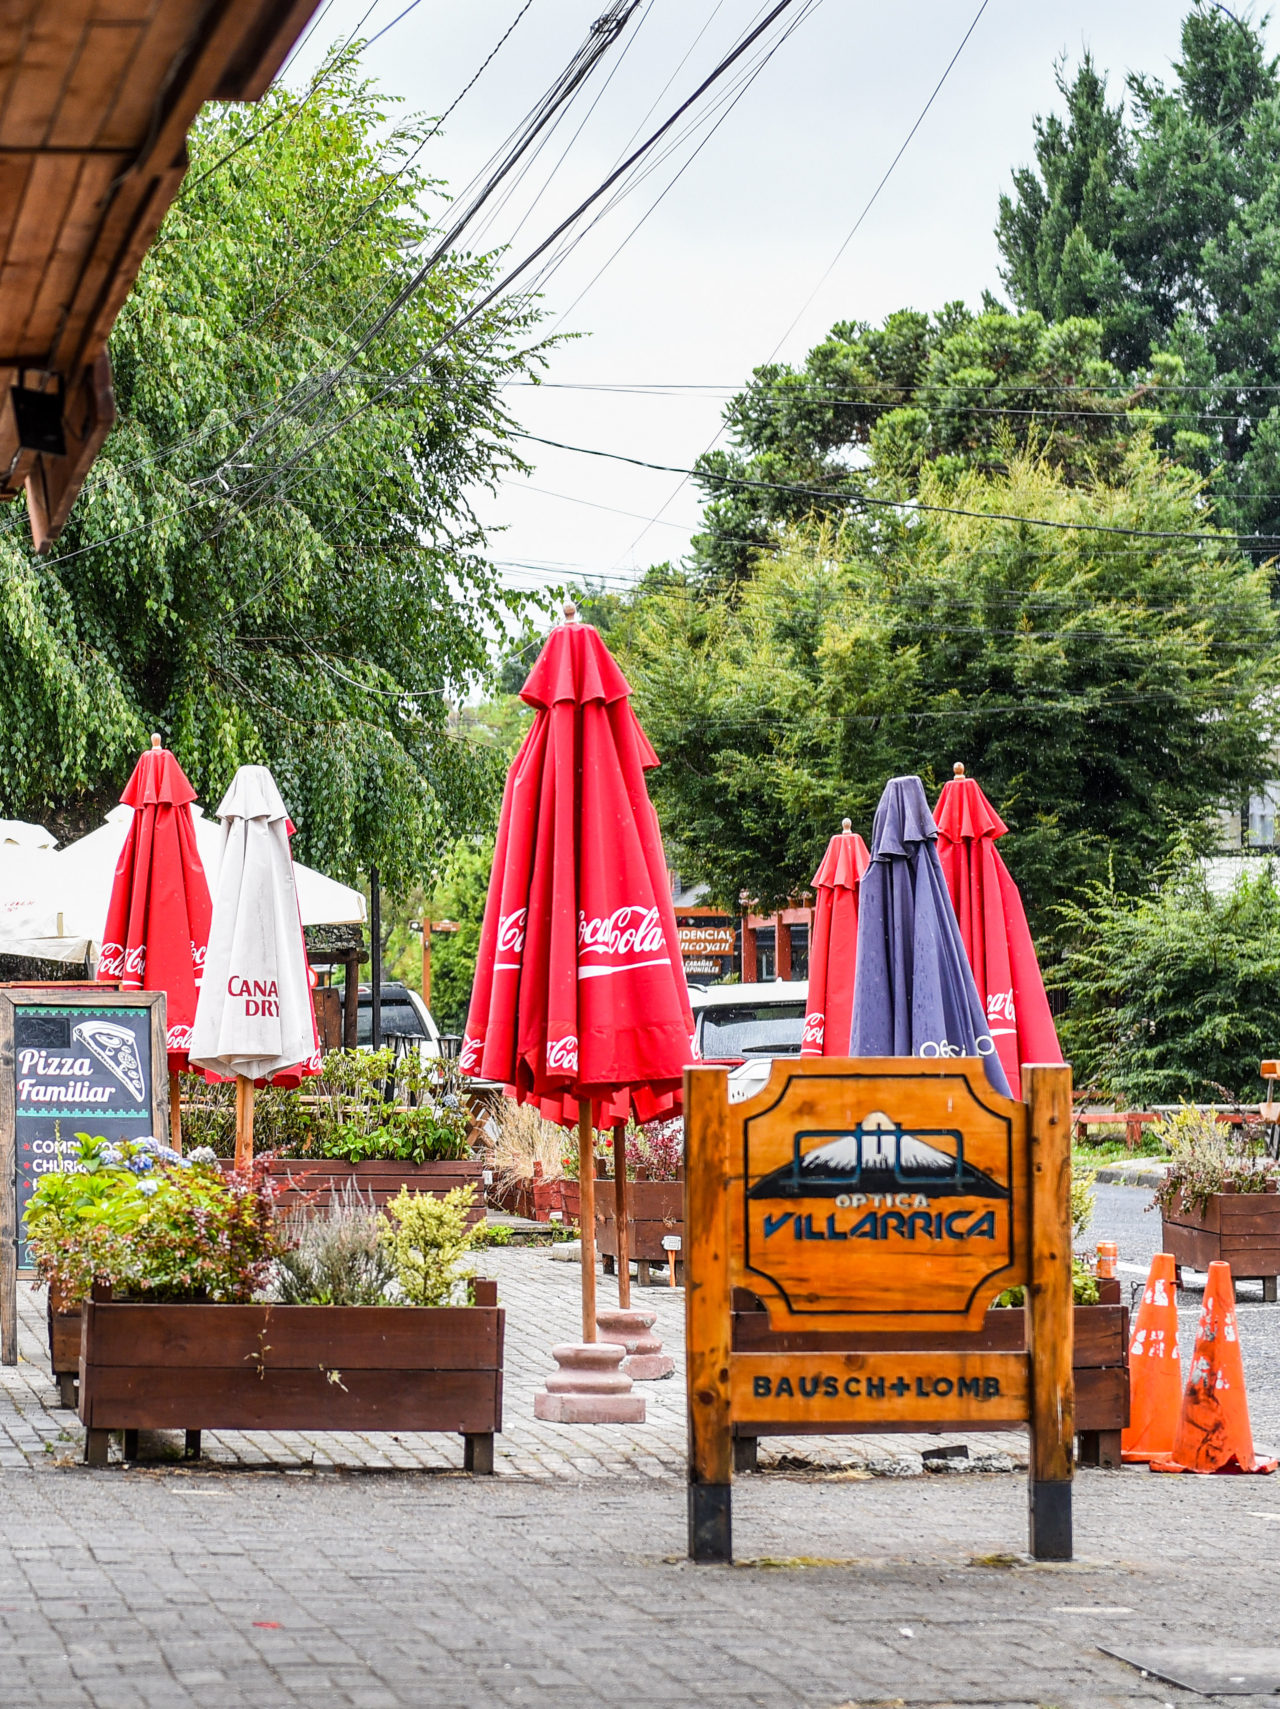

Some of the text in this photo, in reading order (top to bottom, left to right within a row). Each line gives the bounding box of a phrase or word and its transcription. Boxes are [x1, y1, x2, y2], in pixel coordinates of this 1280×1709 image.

[679, 930, 730, 940] IDENCIAL
[680, 941, 730, 954] ncoyan
[228, 975, 279, 998] CANA
[18, 1049, 94, 1076] Pizza
[17, 1079, 116, 1103] Familiar
[835, 1193, 929, 1209] OPTICA
[763, 1211, 996, 1240] VILLARRICA
[753, 1376, 1000, 1398] BAUSCH+LOMB
